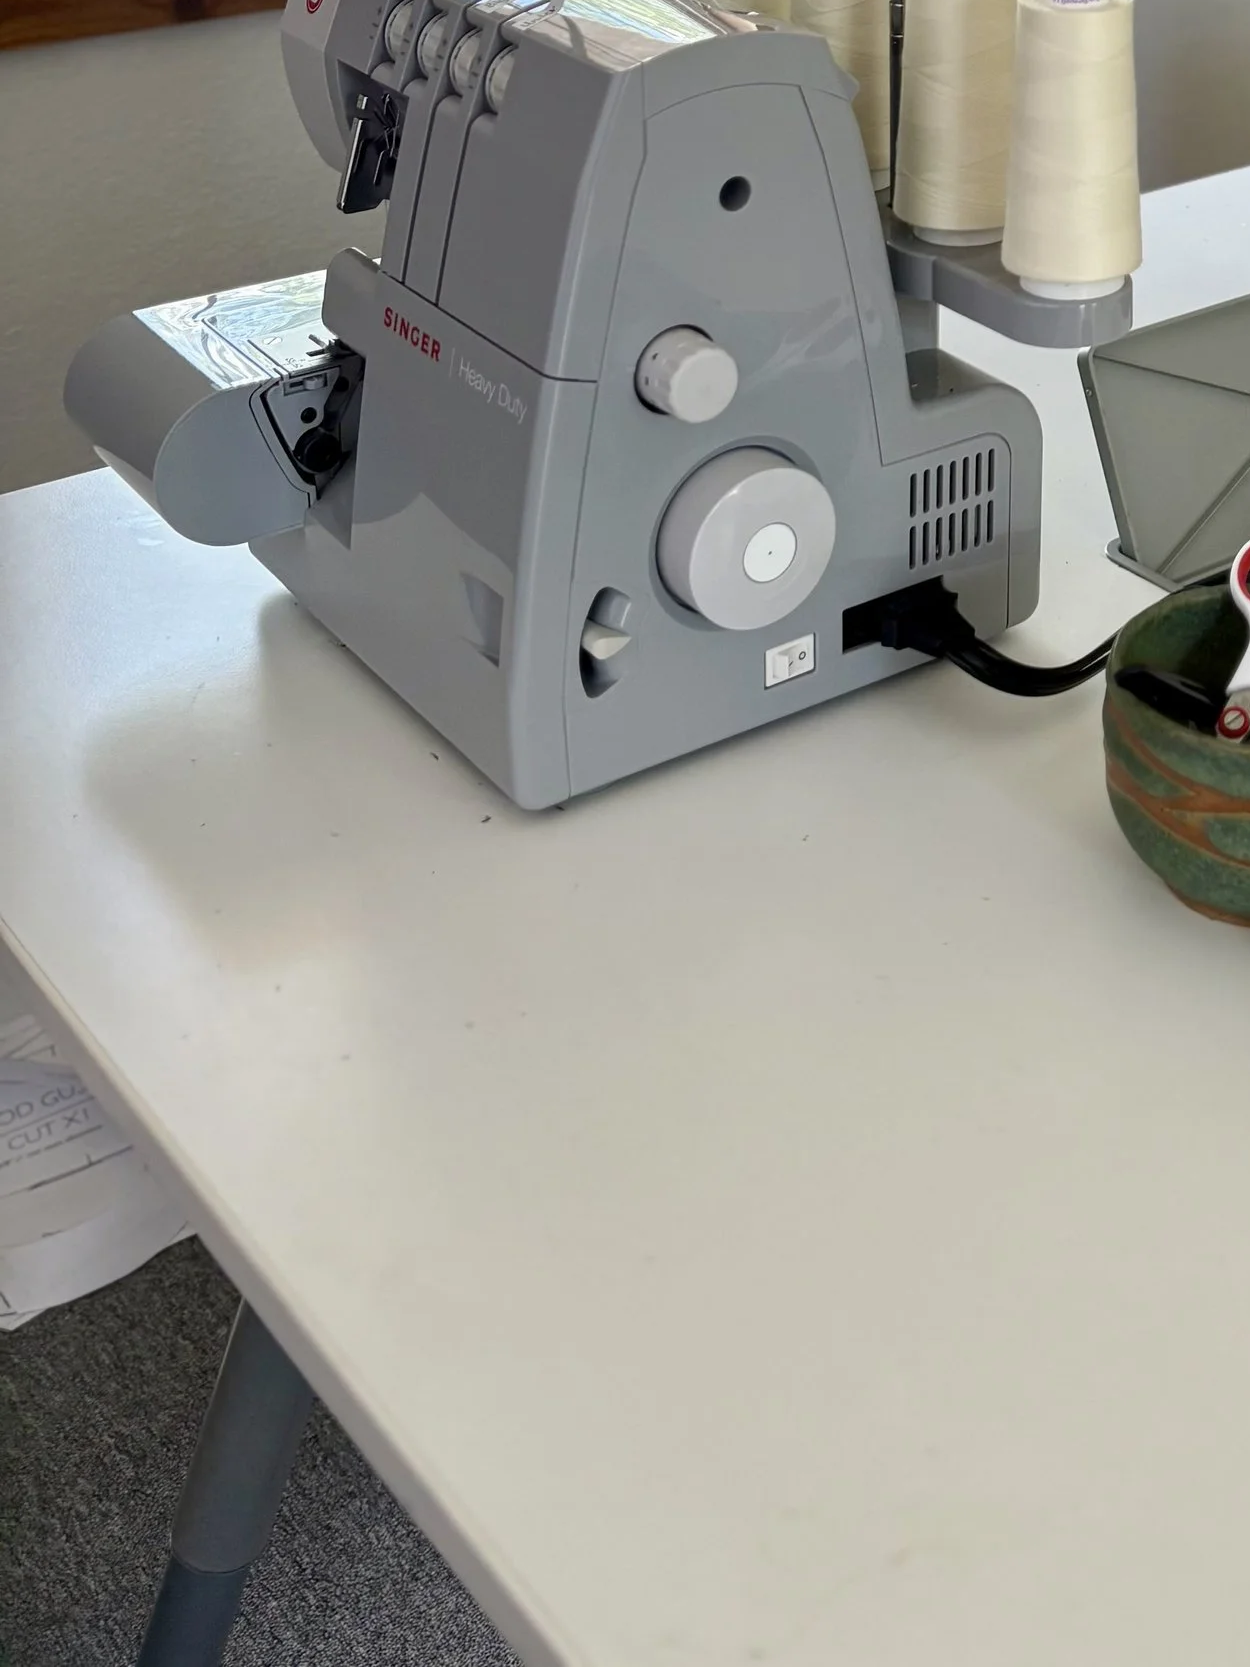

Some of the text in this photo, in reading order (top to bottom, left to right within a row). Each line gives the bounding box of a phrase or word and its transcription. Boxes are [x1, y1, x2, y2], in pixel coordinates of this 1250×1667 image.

[383, 307, 528, 424] SINGER Heavy Duty
[8, 1119, 56, 1150] CUT
